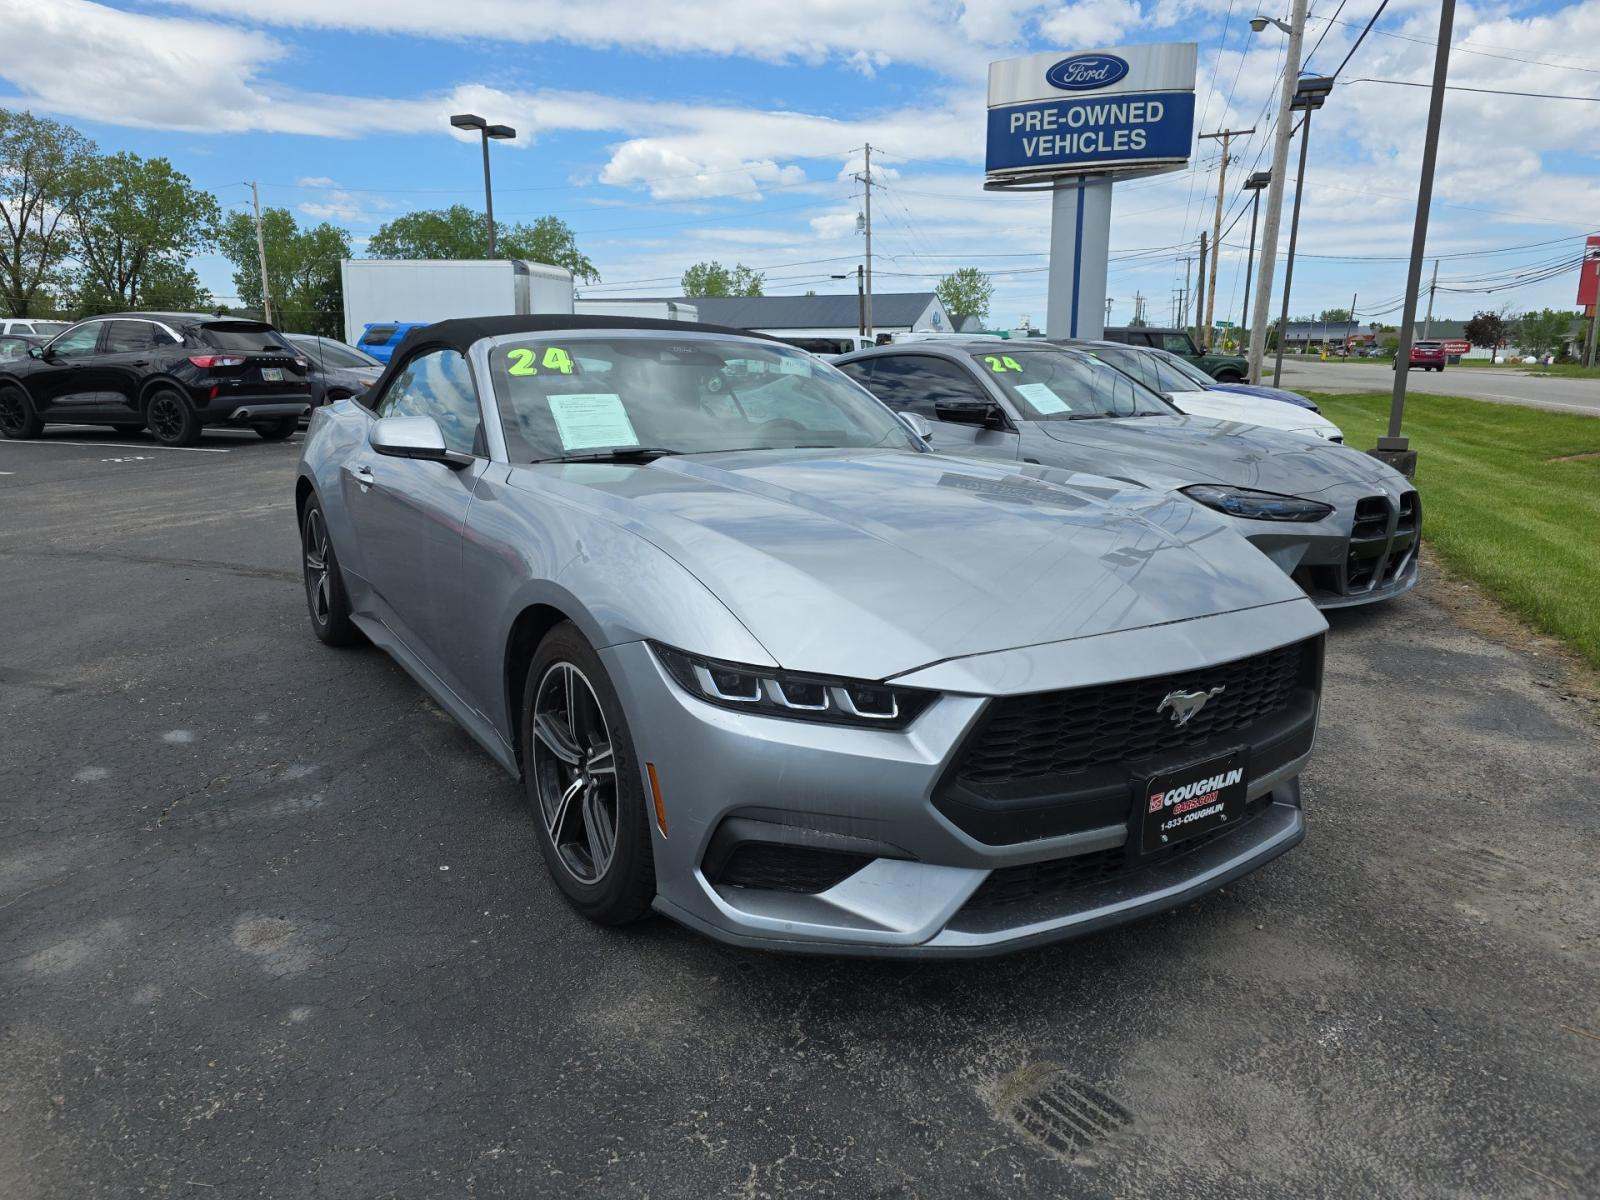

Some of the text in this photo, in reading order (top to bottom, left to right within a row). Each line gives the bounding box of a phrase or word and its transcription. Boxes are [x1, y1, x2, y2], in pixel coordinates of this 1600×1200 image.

[1064, 61, 1107, 83] Ford
[1010, 101, 1164, 134] PRE-OWNED
[1022, 129, 1147, 158] VEHICLES
[507, 347, 575, 376] 24
[984, 356, 1024, 373] 24
[1163, 767, 1244, 807] COUGHLIN
[1161, 802, 1225, 831] 1-833-COUGHLIN
